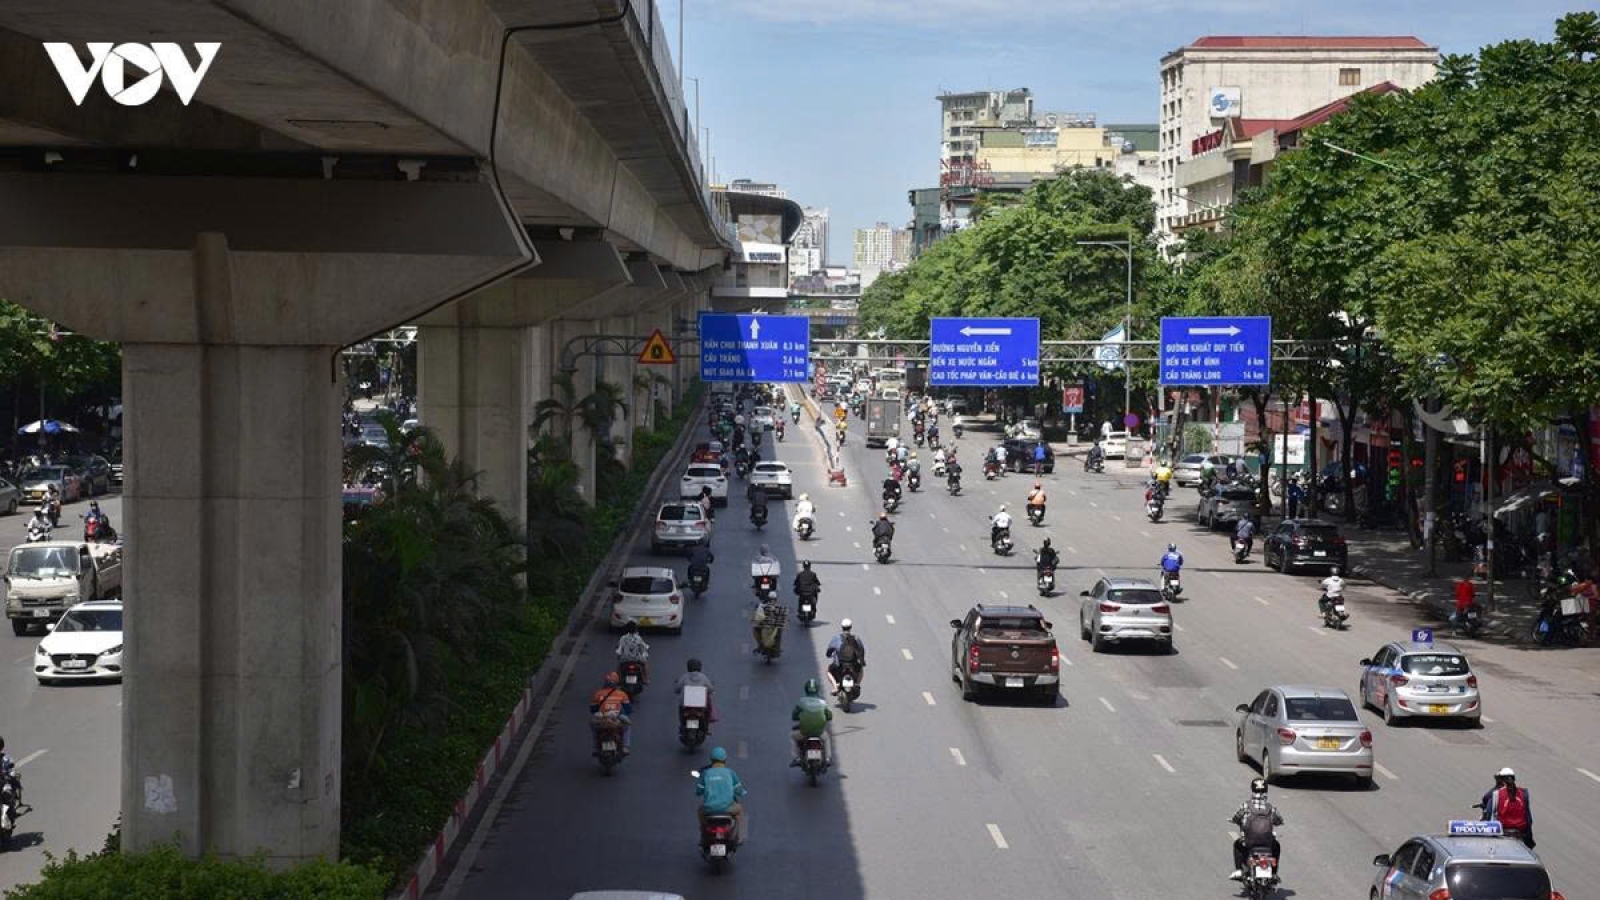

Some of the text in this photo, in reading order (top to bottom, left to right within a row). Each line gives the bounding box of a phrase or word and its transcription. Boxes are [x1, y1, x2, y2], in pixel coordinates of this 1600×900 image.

[738, 341, 758, 349] THANH
[760, 341, 778, 350] XUÂN
[794, 342, 805, 350] km
[957, 341, 982, 352] NGUYỄN
[1214, 344, 1226, 352] DUY
[1230, 341, 1244, 352] TIẾN
[794, 356, 805, 364] km
[933, 355, 945, 366] BẾN
[948, 358, 956, 366] XE
[1022, 358, 1027, 367] 5
[1027, 359, 1037, 367] km
[1181, 358, 1189, 366] XE
[1253, 358, 1264, 366] km
[794, 369, 805, 377] km
[932, 371, 944, 380] CAO
[960, 370, 977, 380] PHÁP
[1027, 372, 1037, 380] km
[1166, 369, 1264, 380] CẦU THĂNG LONG 14 km
